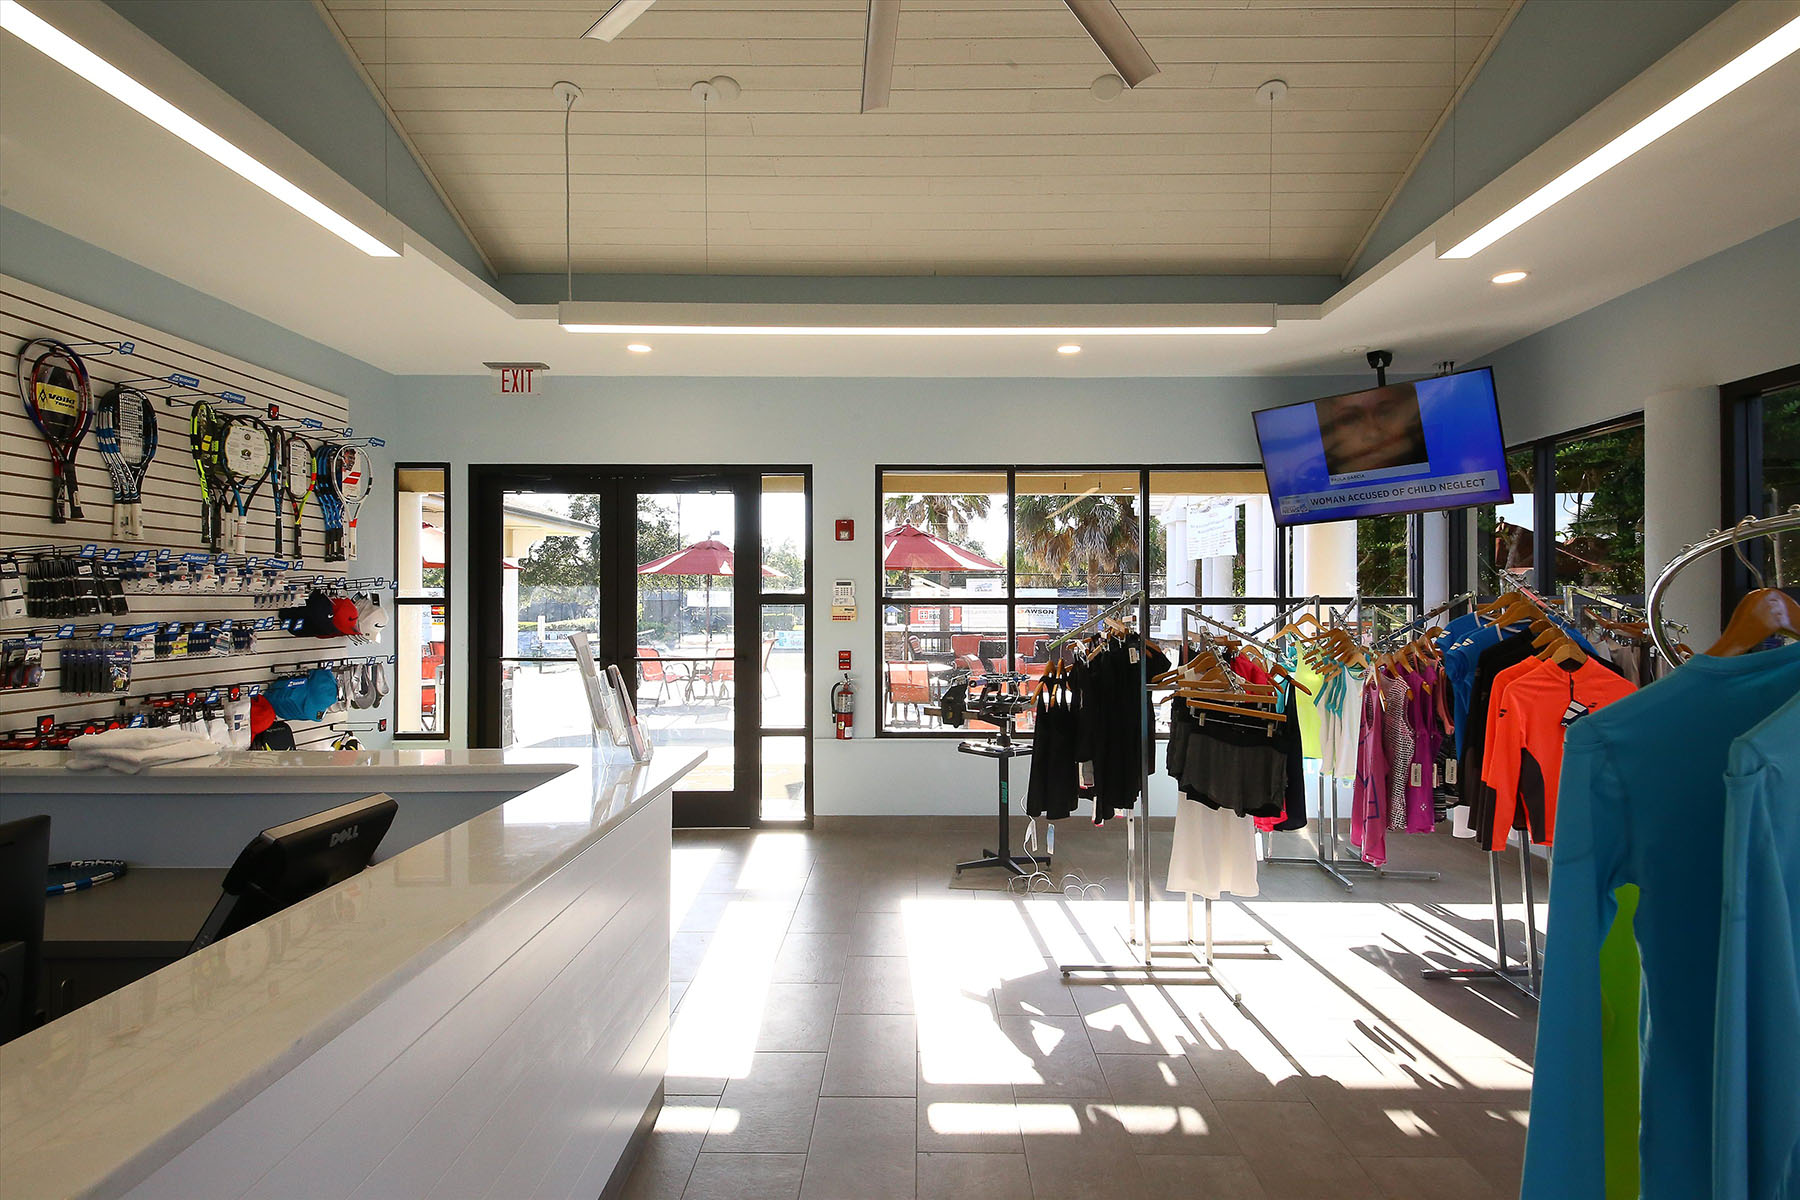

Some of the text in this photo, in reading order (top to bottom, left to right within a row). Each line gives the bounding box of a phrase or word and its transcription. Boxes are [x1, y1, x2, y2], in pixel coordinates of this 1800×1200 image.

[501, 368, 534, 393] EXIT
[1310, 495, 1346, 507] WOMAN
[1347, 489, 1390, 502] ACCUSED
[1391, 487, 1405, 497] OF
[1407, 483, 1437, 495] CHILD
[1439, 477, 1487, 491] NEGLECT
[329, 824, 359, 848] DELL
